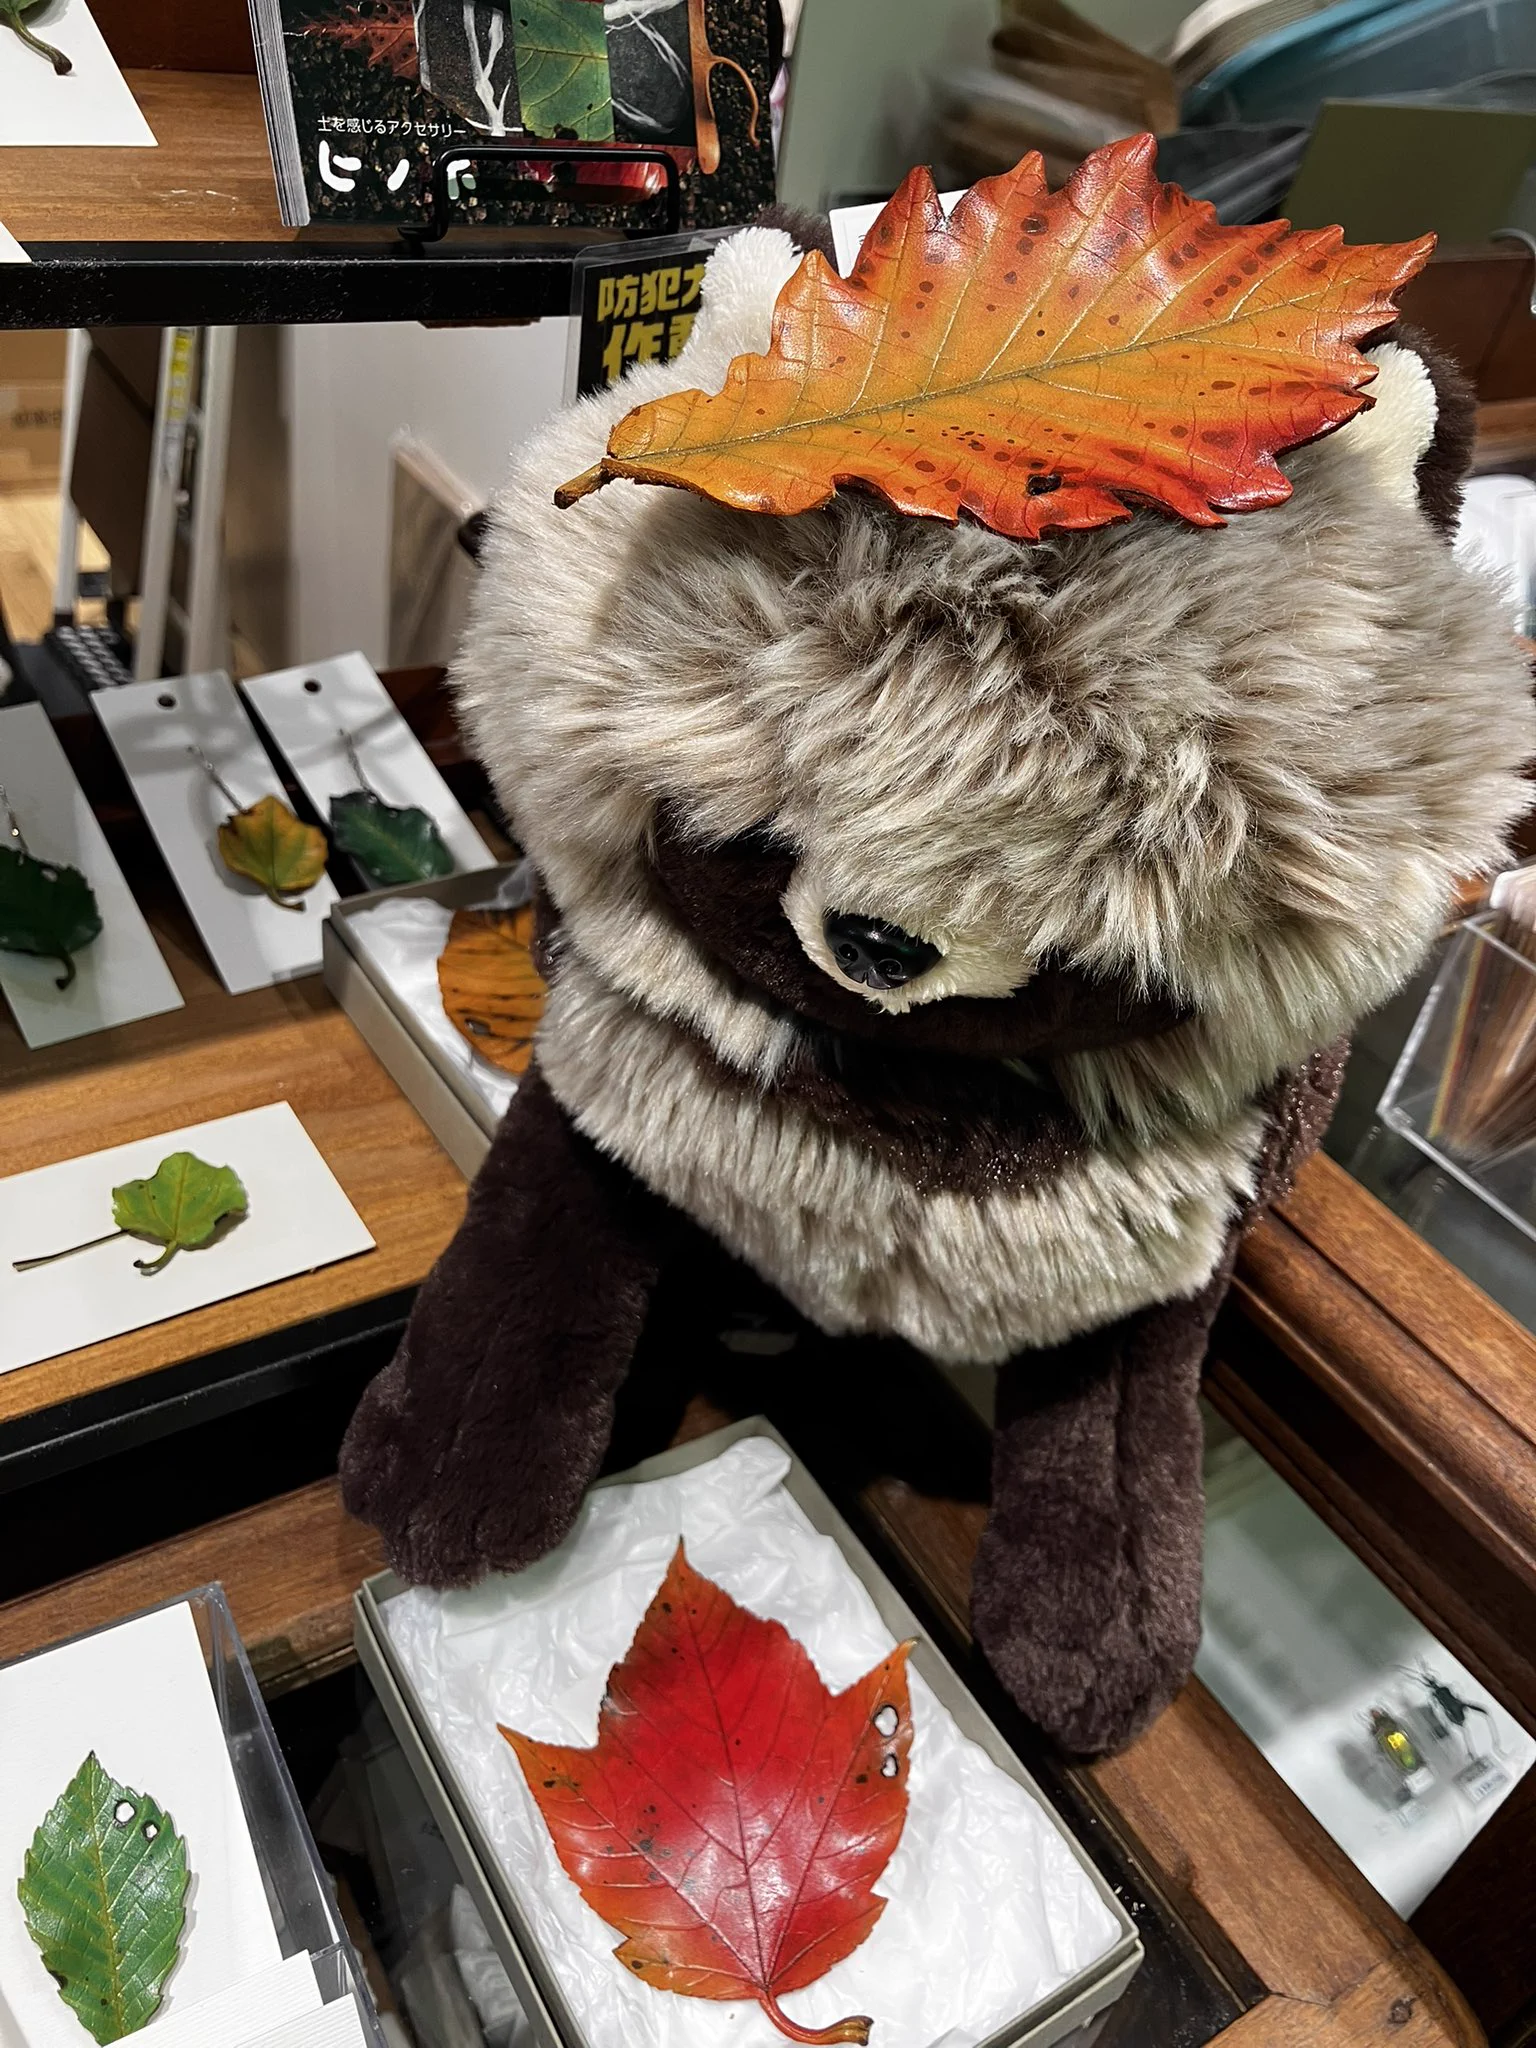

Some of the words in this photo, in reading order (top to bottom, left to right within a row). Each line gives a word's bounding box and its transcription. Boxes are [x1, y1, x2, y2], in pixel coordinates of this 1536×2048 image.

[317, 115, 467, 138] 土を感じるアクセサリー
